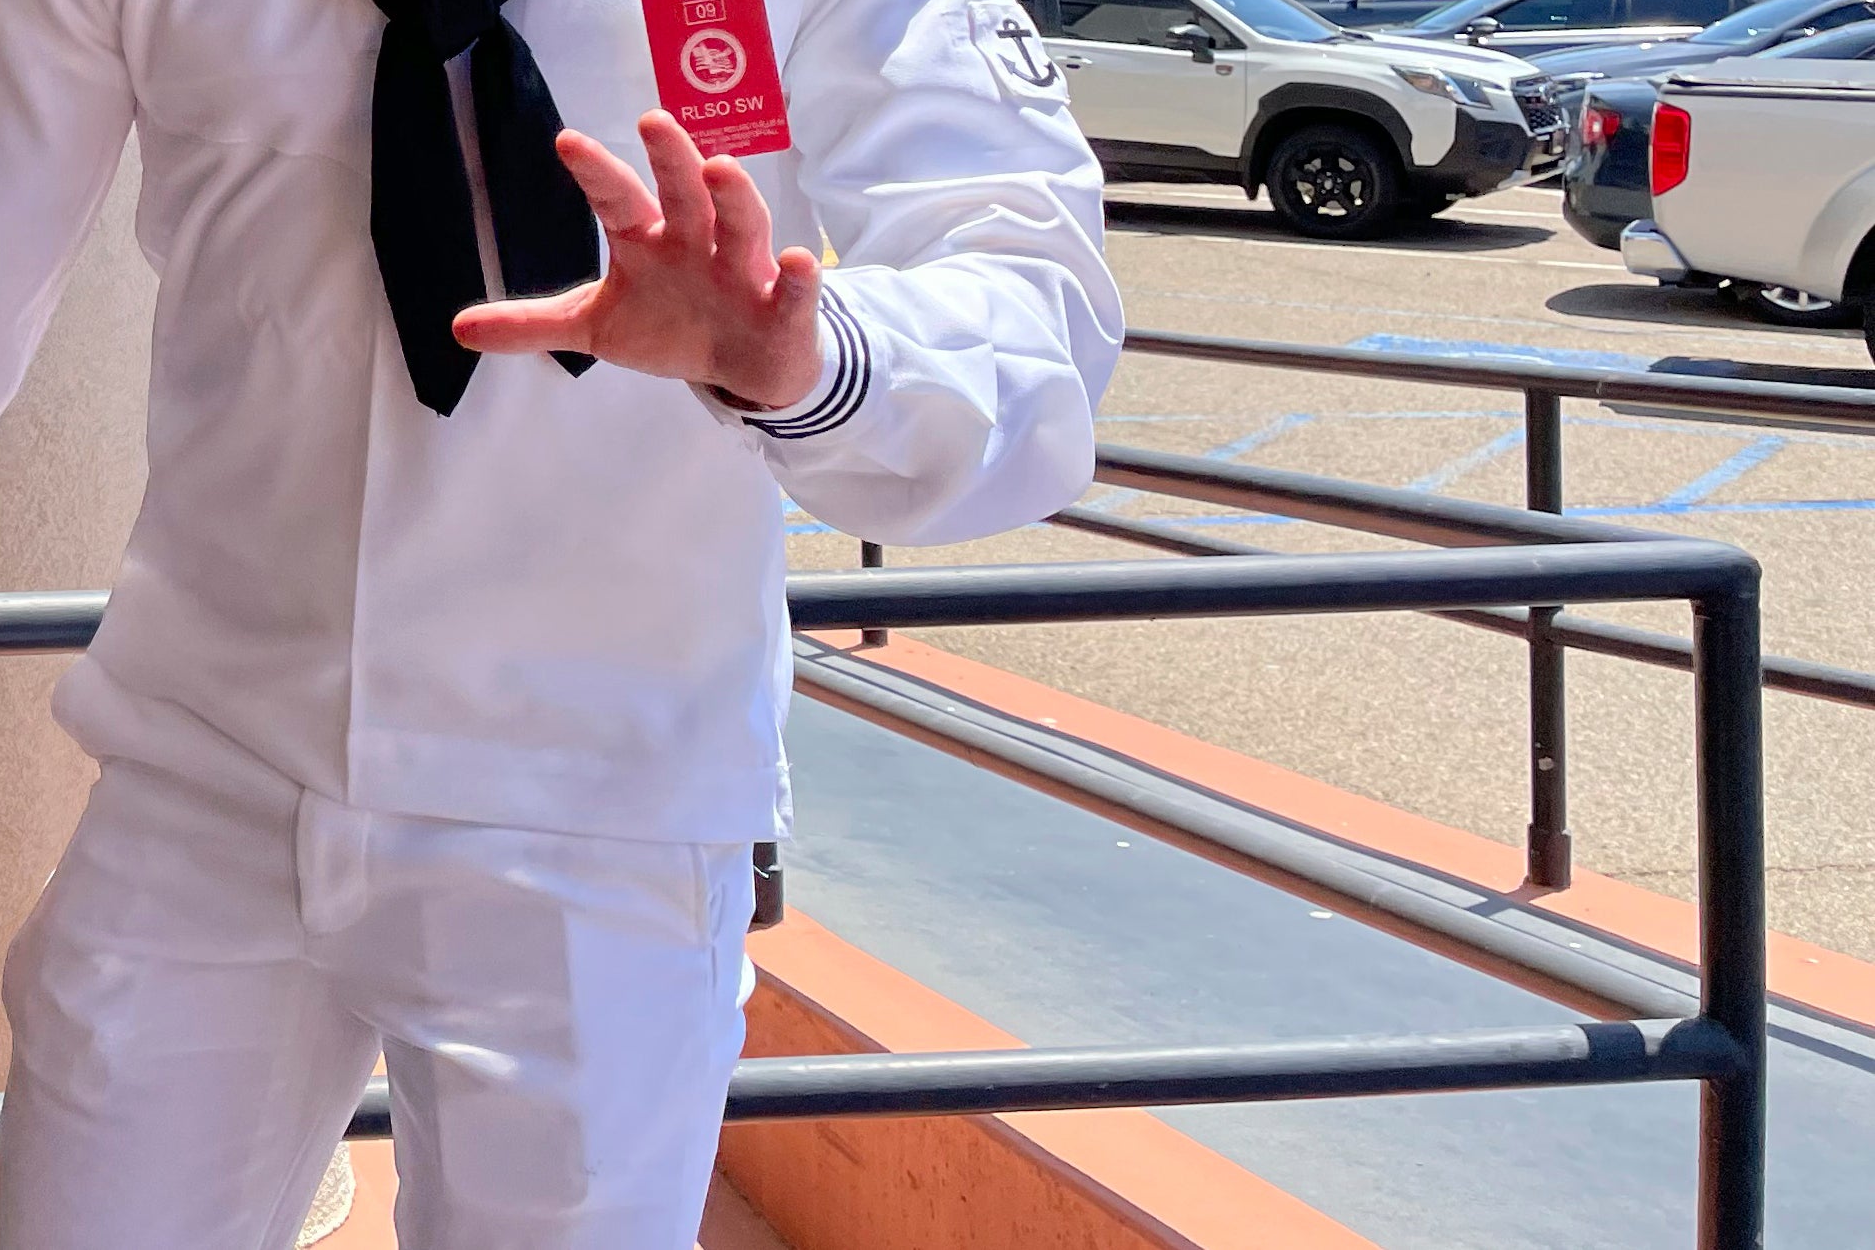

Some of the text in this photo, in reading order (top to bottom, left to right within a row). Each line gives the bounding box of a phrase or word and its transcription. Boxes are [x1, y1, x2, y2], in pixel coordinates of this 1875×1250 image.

[695, 2, 716, 19] 09
[681, 95, 764, 121] RLSO SW
